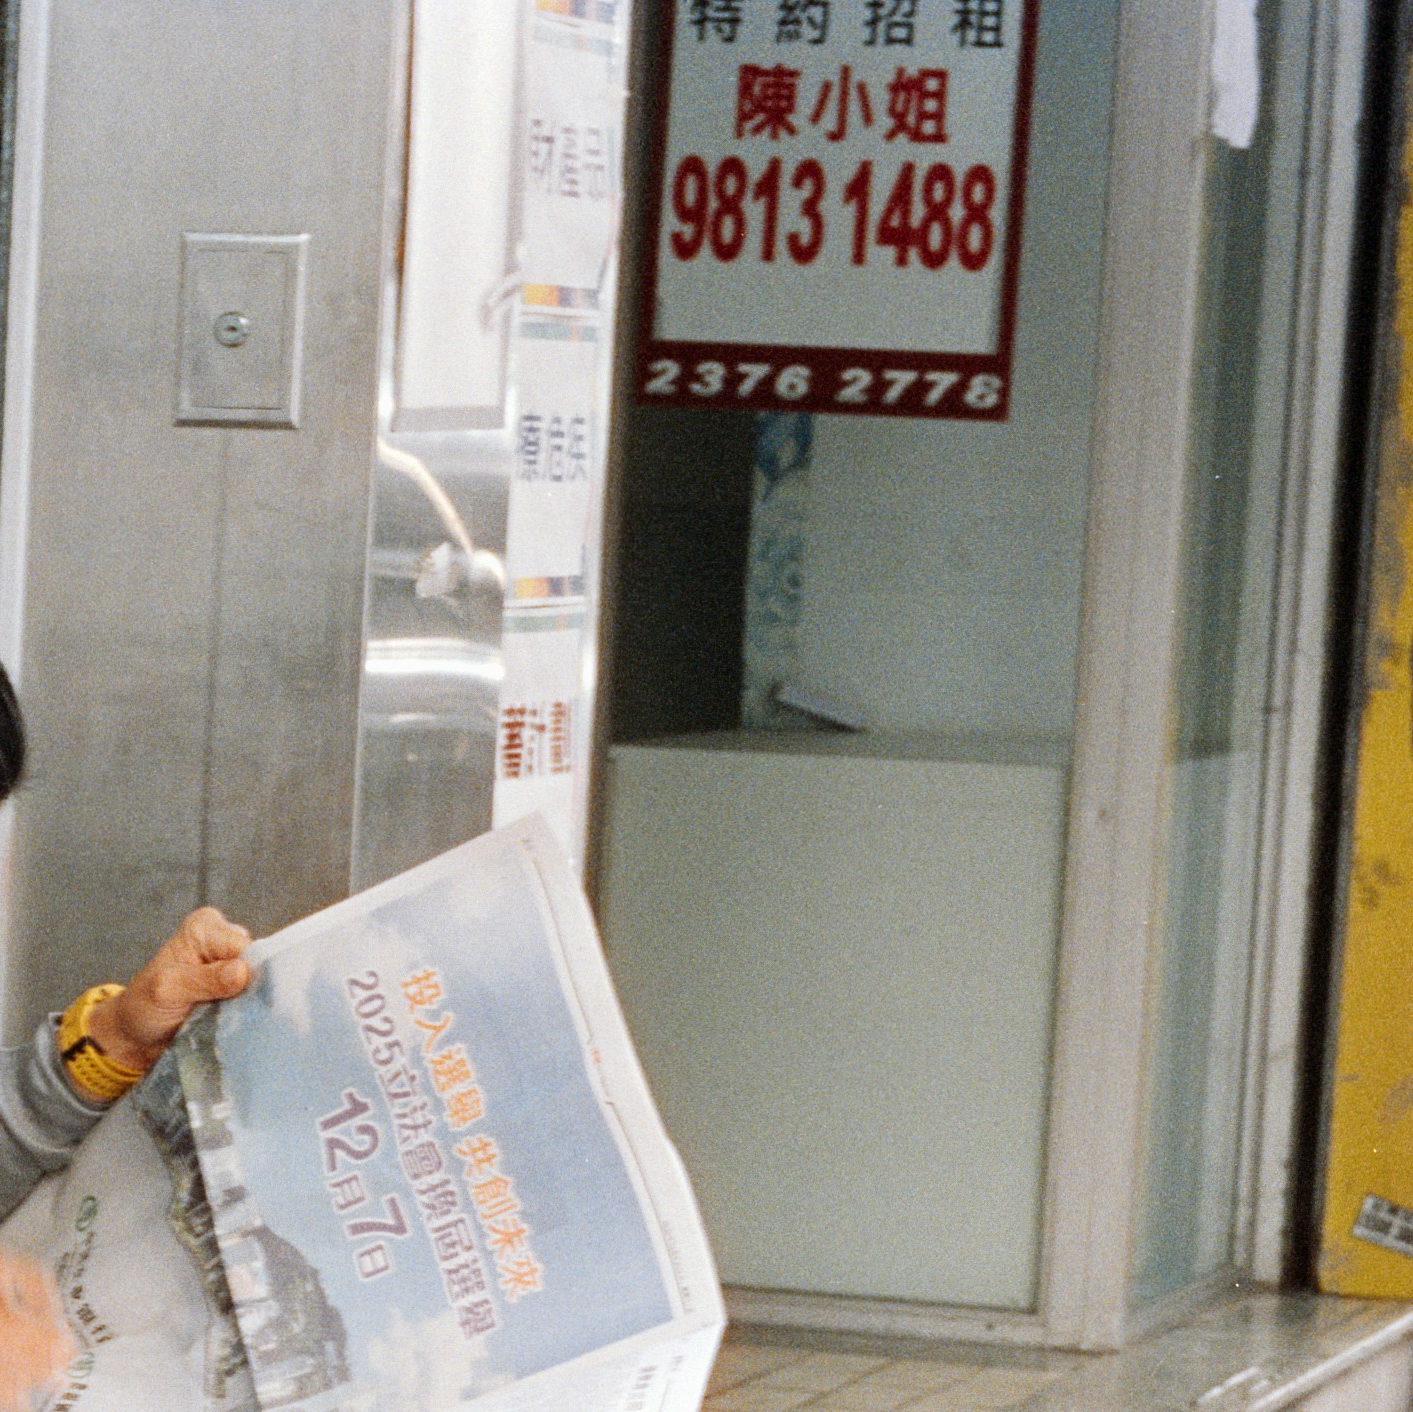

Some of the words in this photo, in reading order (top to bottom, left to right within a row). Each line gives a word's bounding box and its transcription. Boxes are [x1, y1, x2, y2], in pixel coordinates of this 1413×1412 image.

[689, 0, 1006, 48] 特約招租
[733, 63, 950, 144] 陳小姐
[670, 154, 826, 266] 9813
[843, 159, 997, 272] 1488
[645, 358, 814, 401] 2376
[835, 367, 1003, 408] 2778
[399, 967, 486, 1131] 投入選舉
[317, 1087, 410, 1282] 12月7日
